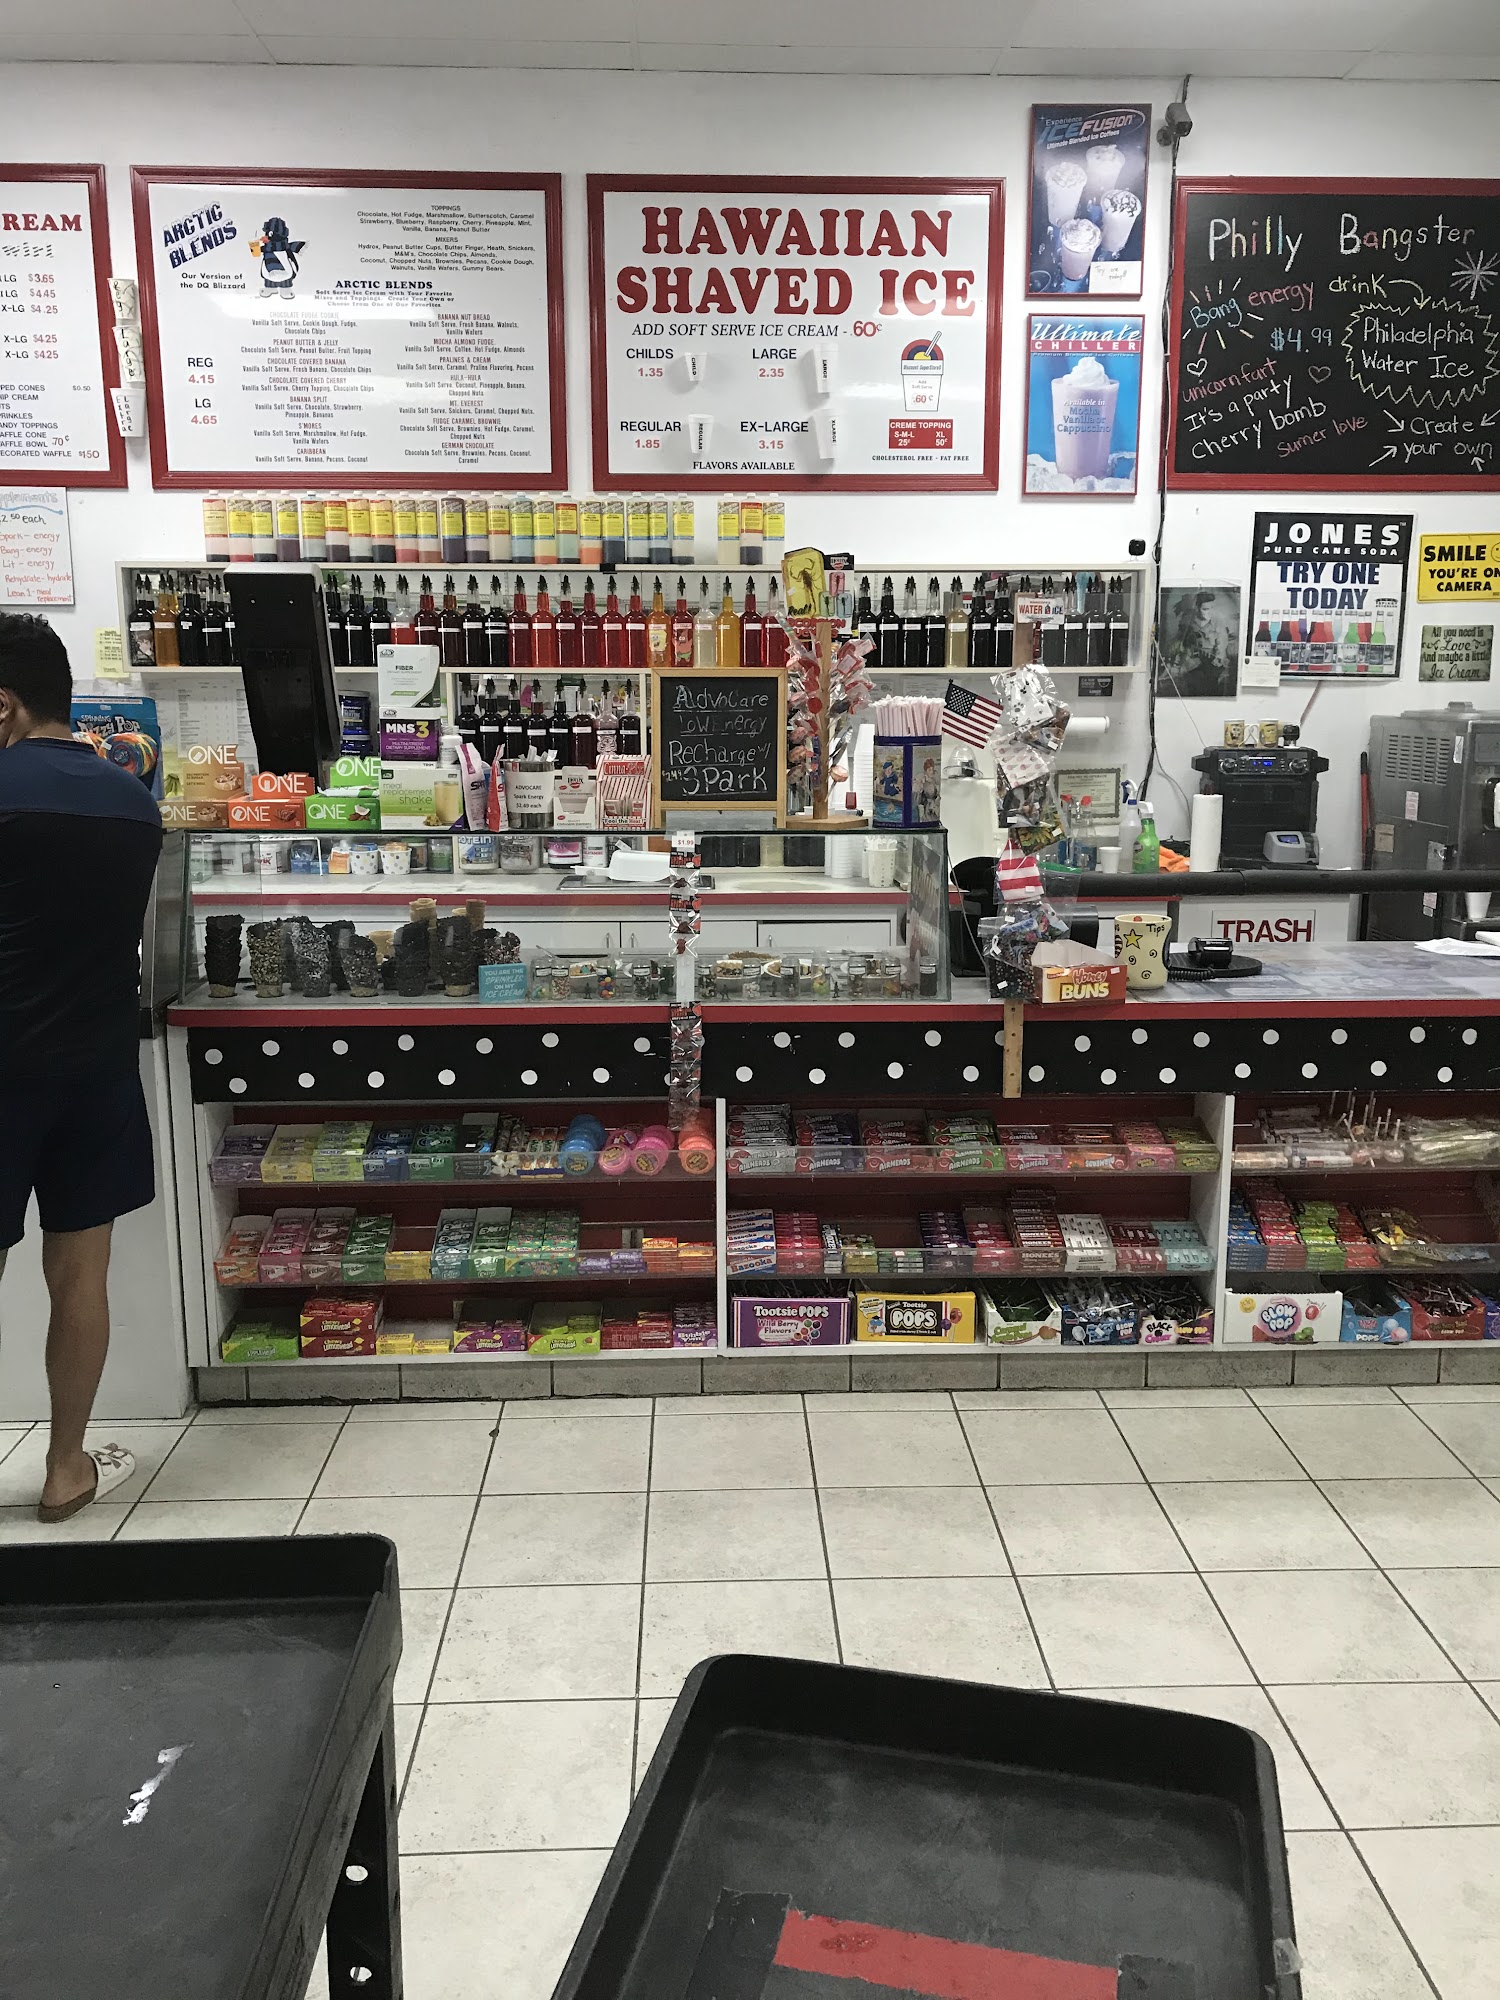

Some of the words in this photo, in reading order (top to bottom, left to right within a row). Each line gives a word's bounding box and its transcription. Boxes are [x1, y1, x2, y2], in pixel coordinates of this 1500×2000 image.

[2, 214, 82, 231] REAM
[163, 201, 222, 247] ARCTIC
[642, 206, 952, 258] HAWAIIAN
[168, 218, 237, 269] BLENDS
[1209, 216, 1303, 272] Philly
[1340, 213, 1475, 262] Bangster
[28, 273, 54, 283] $3.65
[336, 280, 381, 289] ARCTIC
[385, 280, 433, 289] BLENDS
[6, 290, 18, 298] LG
[616, 266, 853, 316] SHAVED
[879, 269, 975, 317] ICE
[1189, 298, 1242, 328] Bang
[1248, 283, 1314, 312] energy
[1329, 274, 1387, 298] drink
[2, 304, 25, 312] X-LG
[31, 304, 58, 314] $4.25
[632, 324, 665, 336] ADD
[668, 324, 707, 336] SOFT
[711, 324, 755, 337] SERVE
[759, 325, 783, 337] ICE
[787, 325, 839, 337] CREAM
[1032, 322, 1142, 341] Ultimate
[1363, 316, 1474, 351] Philadelphia
[4, 335, 27, 343] X-LG
[1035, 342, 1136, 350] CHILLER
[626, 349, 673, 359] CHILDS
[752, 349, 797, 360] LARGE
[188, 357, 213, 367] REG
[1362, 349, 1418, 374] Water
[1428, 355, 1474, 378] Ice
[188, 374, 214, 384] 4.15
[638, 367, 663, 377] 1.35
[758, 368, 784, 378] 2.35
[195, 399, 211, 408] LG
[1184, 406, 1222, 432] It's
[1228, 400, 1240, 413] a
[1244, 375, 1292, 416] party
[191, 415, 217, 425] 4.65
[1333, 416, 1368, 436] love
[1410, 415, 1475, 435] Create
[620, 421, 682, 432] REGULAR
[740, 421, 809, 433] EX-LARGE
[1057, 424, 1111, 434] Cappuccino
[1191, 419, 1263, 459] Cherry
[1269, 397, 1327, 430] bomb
[635, 439, 660, 449] 1.85
[758, 440, 784, 450] 3.15
[1403, 441, 1442, 464] your
[1454, 443, 1493, 460] own
[693, 461, 738, 471] FLAVORS
[741, 462, 795, 471] AVAILABLE
[22, 514, 46, 524] each
[34, 533, 60, 542] energy
[1264, 522, 1400, 546] JONES
[1264, 546, 1303, 554] PURE
[1313, 546, 1351, 555] CANE
[1361, 547, 1398, 556] SODA
[1423, 544, 1487, 563] SMILE
[1277, 561, 1324, 584] TRY
[1332, 562, 1380, 585] ONE
[1428, 568, 1477, 579] YOU'RE
[1436, 581, 1492, 592] CAMERA
[1287, 587, 1369, 610] TODAY
[1019, 604, 1043, 614] WATER
[1052, 605, 1064, 615] ICE
[1440, 638, 1471, 651] Love
[1429, 663, 1445, 678] Ice
[1449, 664, 1481, 679] Cream
[188, 745, 239, 765] ONE
[258, 773, 307, 794] ONE
[400, 795, 432, 804] shake
[231, 806, 271, 822] ONE
[308, 803, 347, 820] ONE
[1146, 924, 1165, 937] Tips
[1217, 918, 1312, 943] TRASH
[485, 975, 524, 984] SPRINKLES
[1072, 969, 1107, 985] Honey
[1061, 983, 1109, 1000] BUNS
[739, 1161, 770, 1171] AIRHEADS
[809, 1159, 841, 1171] AIRHEADS
[731, 1258, 772, 1272] Bazooka
[902, 1301, 927, 1309] Tootsie
[754, 1306, 798, 1317] Tootsie
[799, 1306, 829, 1318] POPS
[892, 1310, 936, 1327] POPS
[1262, 1304, 1297, 1322] BLOW
[757, 1319, 775, 1328] Wild
[777, 1320, 799, 1329] Berry
[1146, 1322, 1172, 1332] BLACK
[1270, 1318, 1293, 1332] POP
